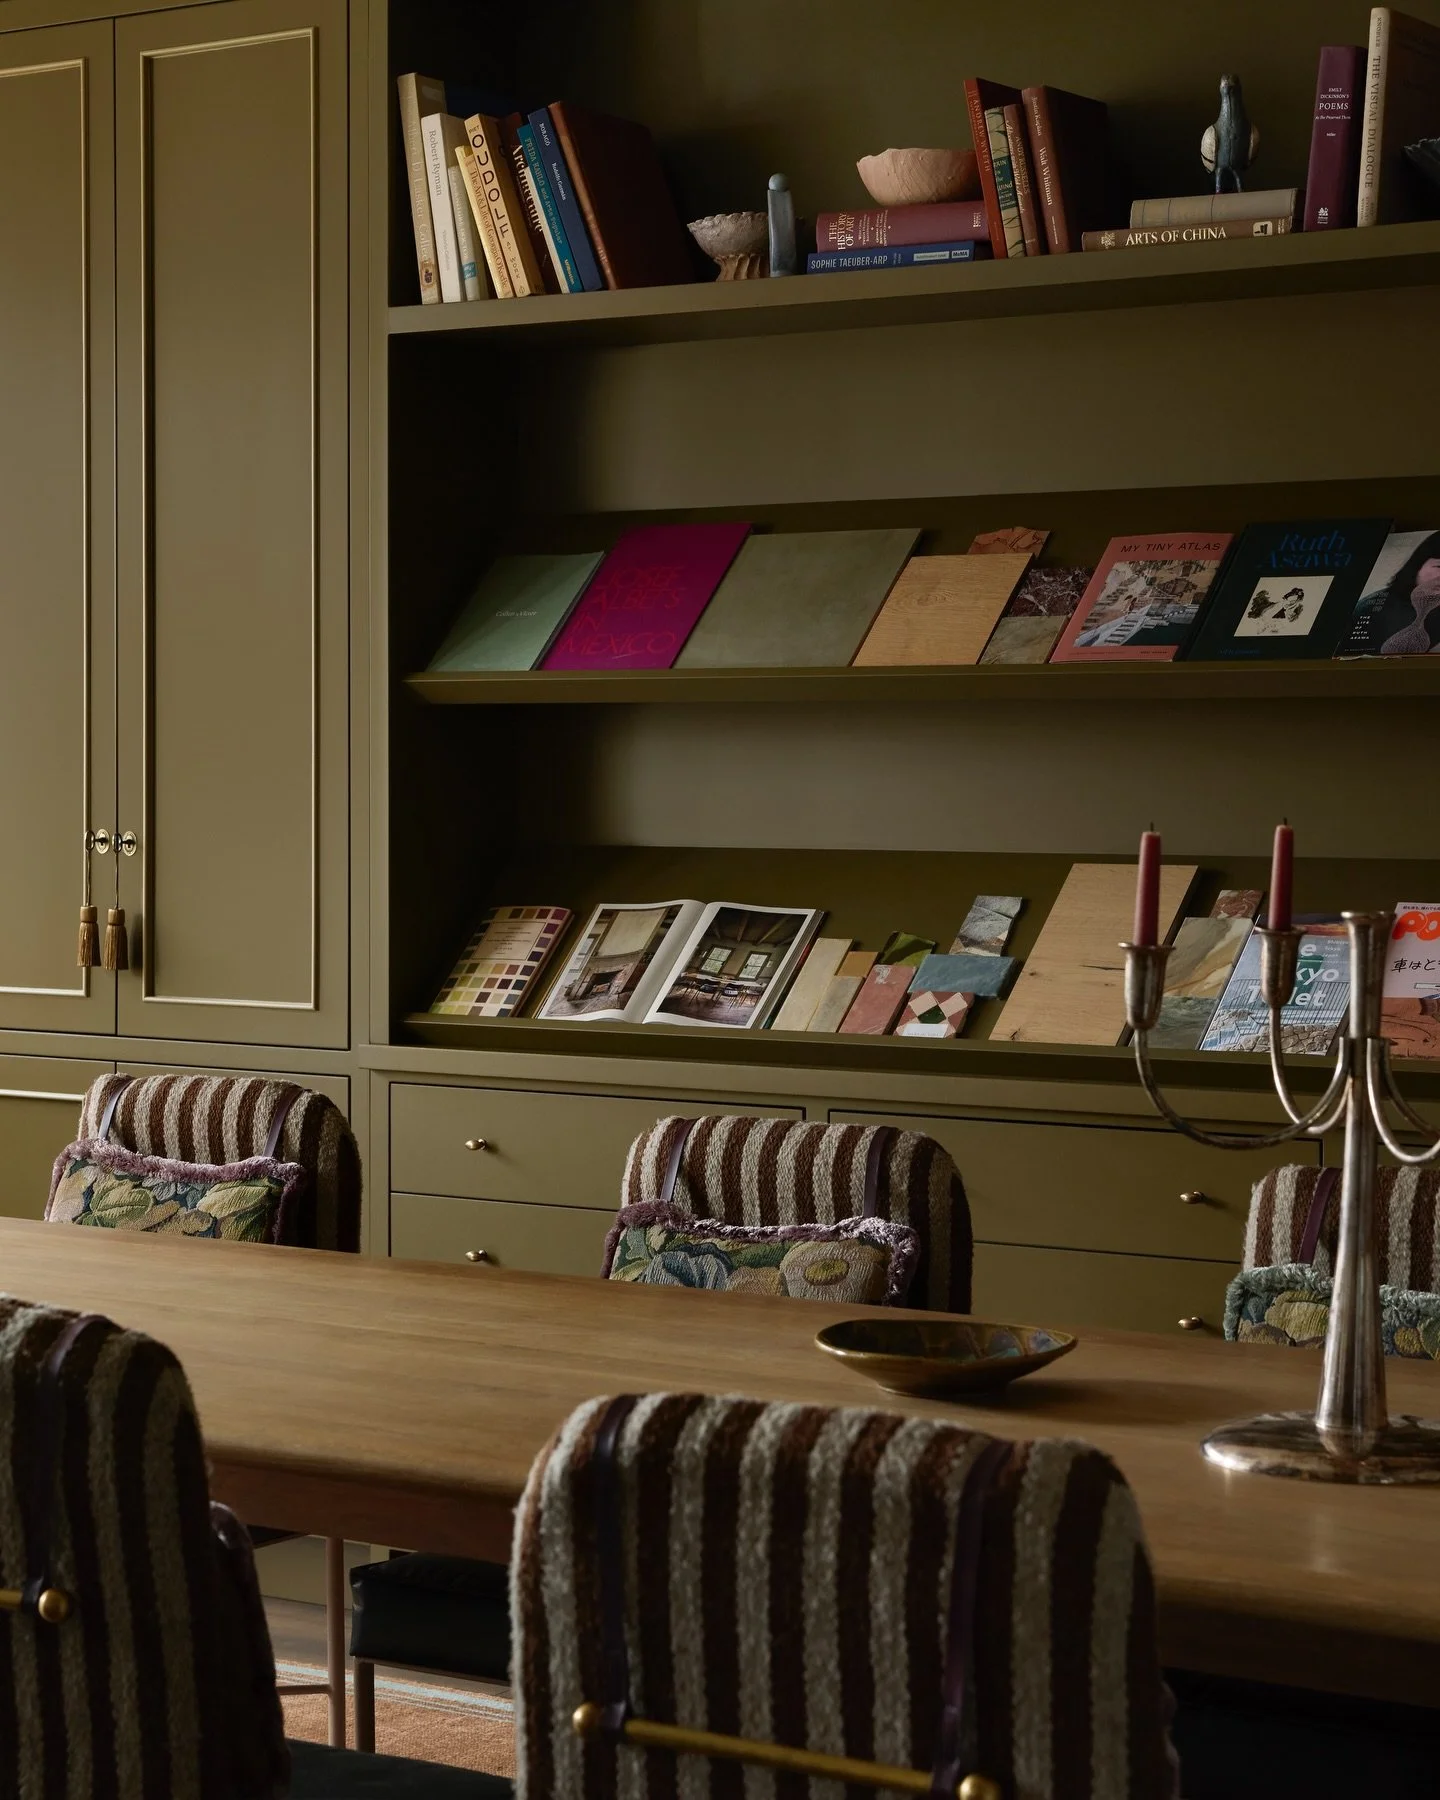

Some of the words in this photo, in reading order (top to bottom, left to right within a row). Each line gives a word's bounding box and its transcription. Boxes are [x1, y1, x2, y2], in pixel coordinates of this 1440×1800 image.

[1372, 55, 1381, 79] THE
[1319, 102, 1349, 110] POEMS
[1369, 83, 1379, 124] VISUAL
[428, 130, 439, 162] Robert
[973, 99, 985, 138] ANDREW
[980, 138, 991, 172] WYETH
[525, 138, 536, 161] FRIDA
[532, 162, 545, 187] KAHLO
[1039, 146, 1048, 165] Walt
[1365, 128, 1377, 188] DIALOGUE
[431, 163, 442, 196] Ryman
[470, 170, 480, 186] The
[472, 134, 509, 238] OUDOLF
[1042, 166, 1054, 206] Whitman
[829, 222, 838, 242] THE
[837, 212, 847, 250] HISTORY
[845, 216, 855, 232] ART
[845, 233, 854, 247] OF
[1125, 231, 1158, 247] ARTS
[1161, 230, 1179, 243] OF
[1182, 227, 1227, 241] CHINA
[811, 259, 837, 269] SOPHIE
[839, 255, 888, 267] TAEUBER-ARP
[1120, 544, 1140, 553] MY
[1146, 543, 1174, 551] TINY
[1178, 542, 1221, 551] ATLAS
[1279, 530, 1345, 551] Ruth
[1296, 961, 1340, 985] kyo
